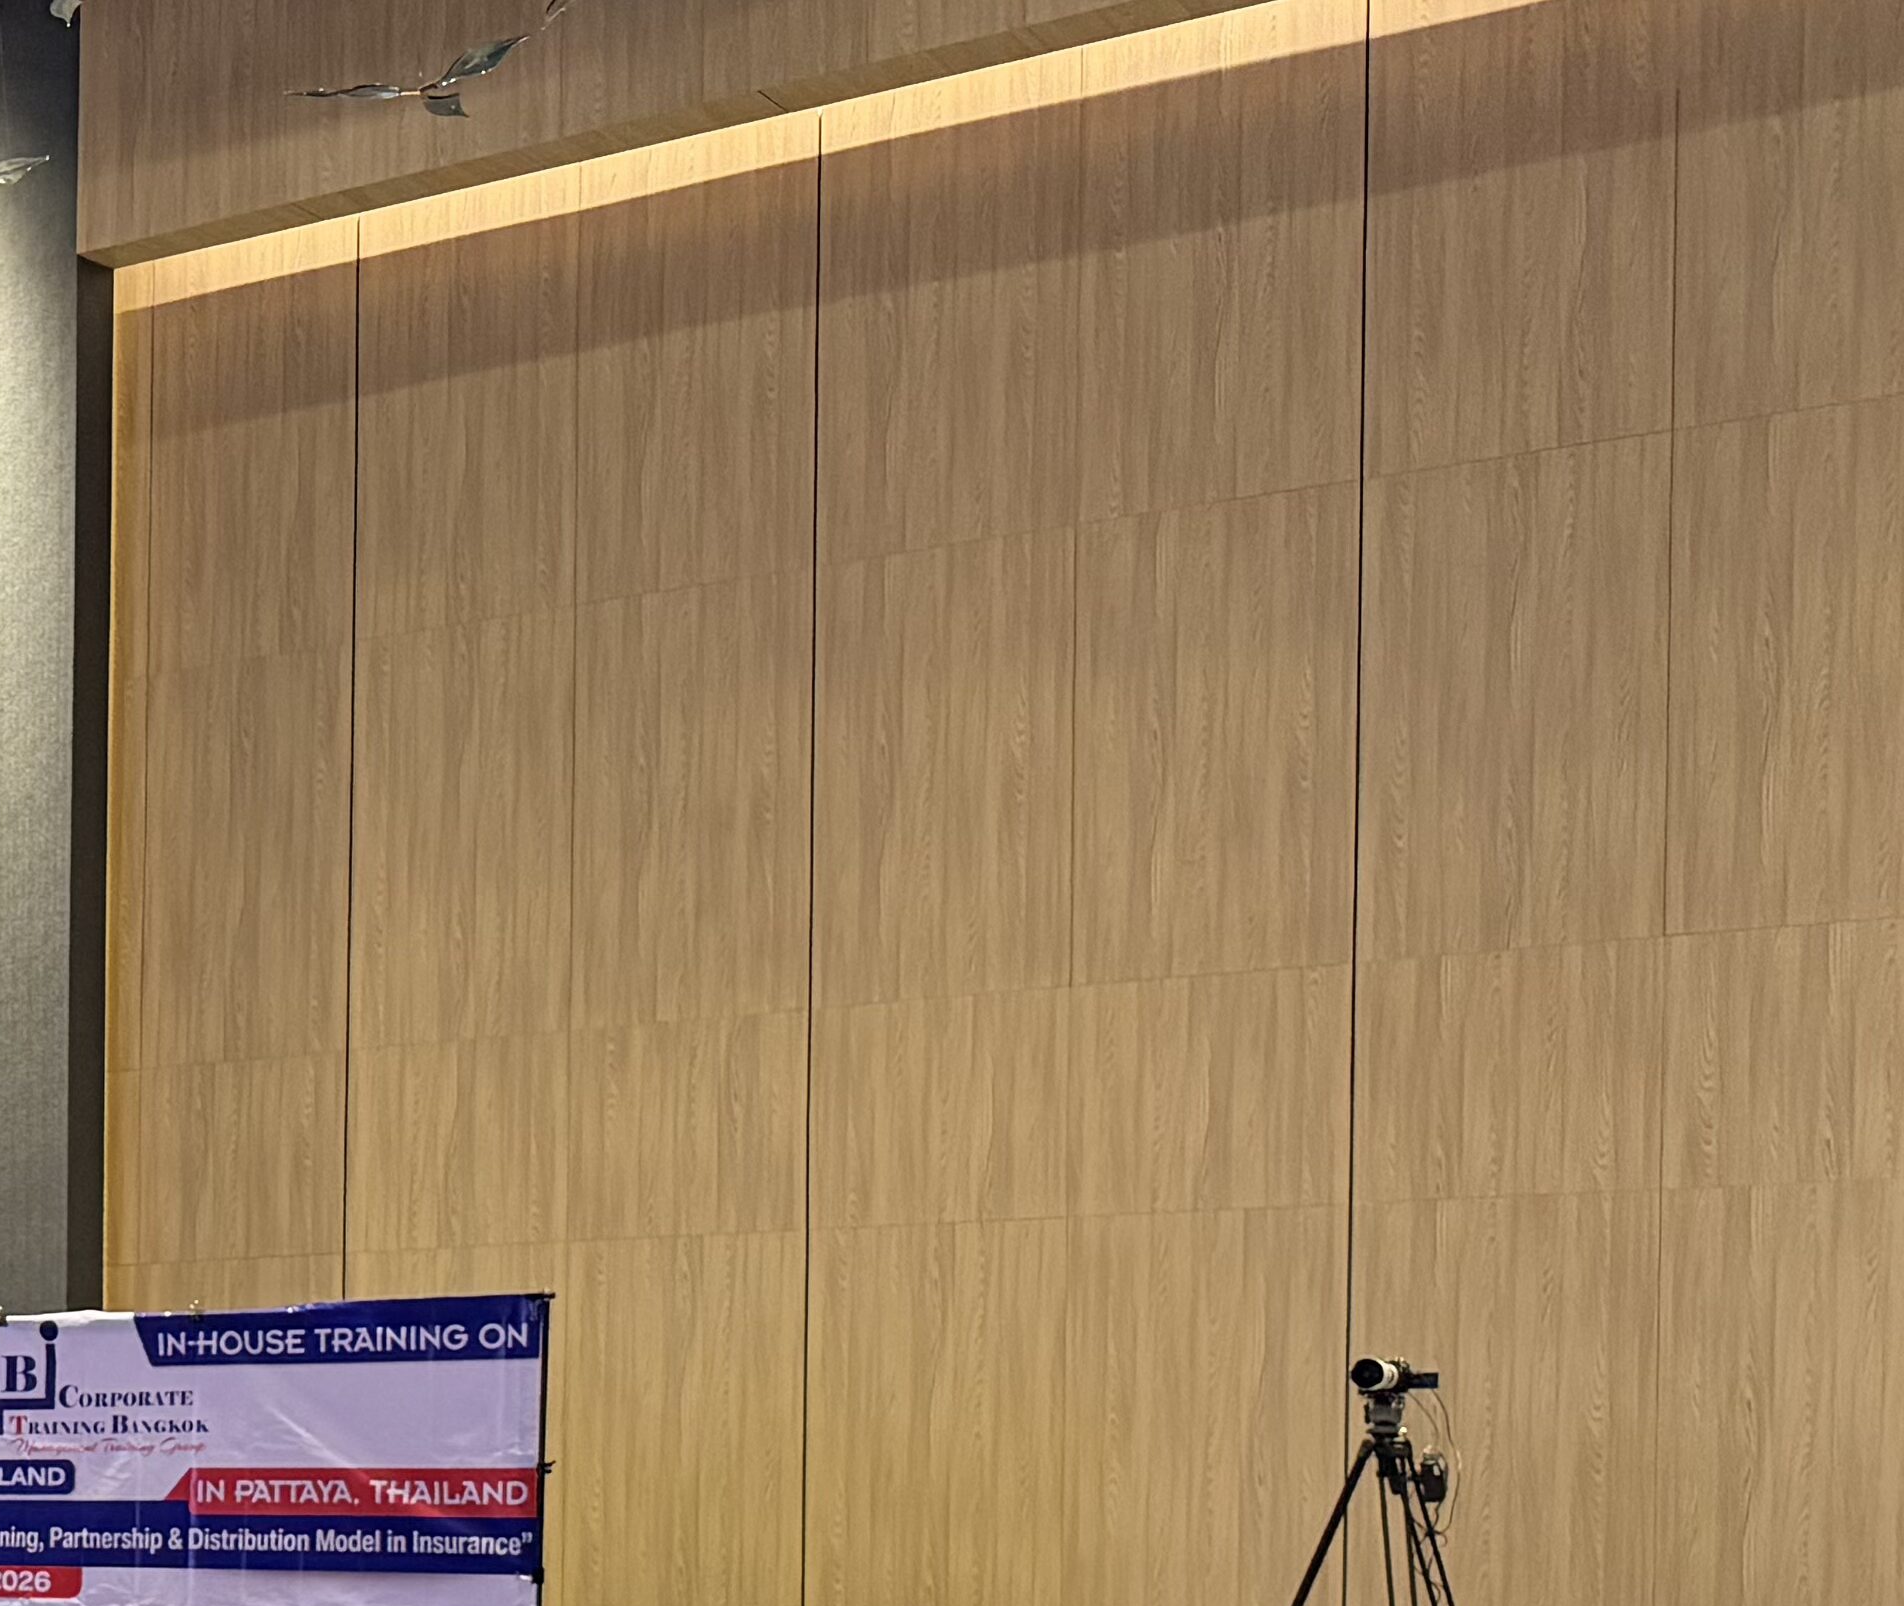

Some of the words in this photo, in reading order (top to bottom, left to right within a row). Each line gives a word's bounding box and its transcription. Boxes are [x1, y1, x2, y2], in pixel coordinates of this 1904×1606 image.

[157, 1328, 305, 1356] IN-HOUSE
[313, 1323, 468, 1353] TRAINING
[478, 1321, 529, 1349] ON
[58, 1384, 194, 1409] CORPORATE
[8, 1415, 105, 1435] TRAINING
[111, 1413, 210, 1434] BANGKOK
[196, 1481, 226, 1503] IN
[369, 1479, 528, 1506] THAILAND
[49, 1526, 163, 1554] Partnership
[167, 1527, 184, 1549] &
[188, 1527, 310, 1552] Distribution
[315, 1529, 381, 1553] Model
[387, 1530, 407, 1553] in
